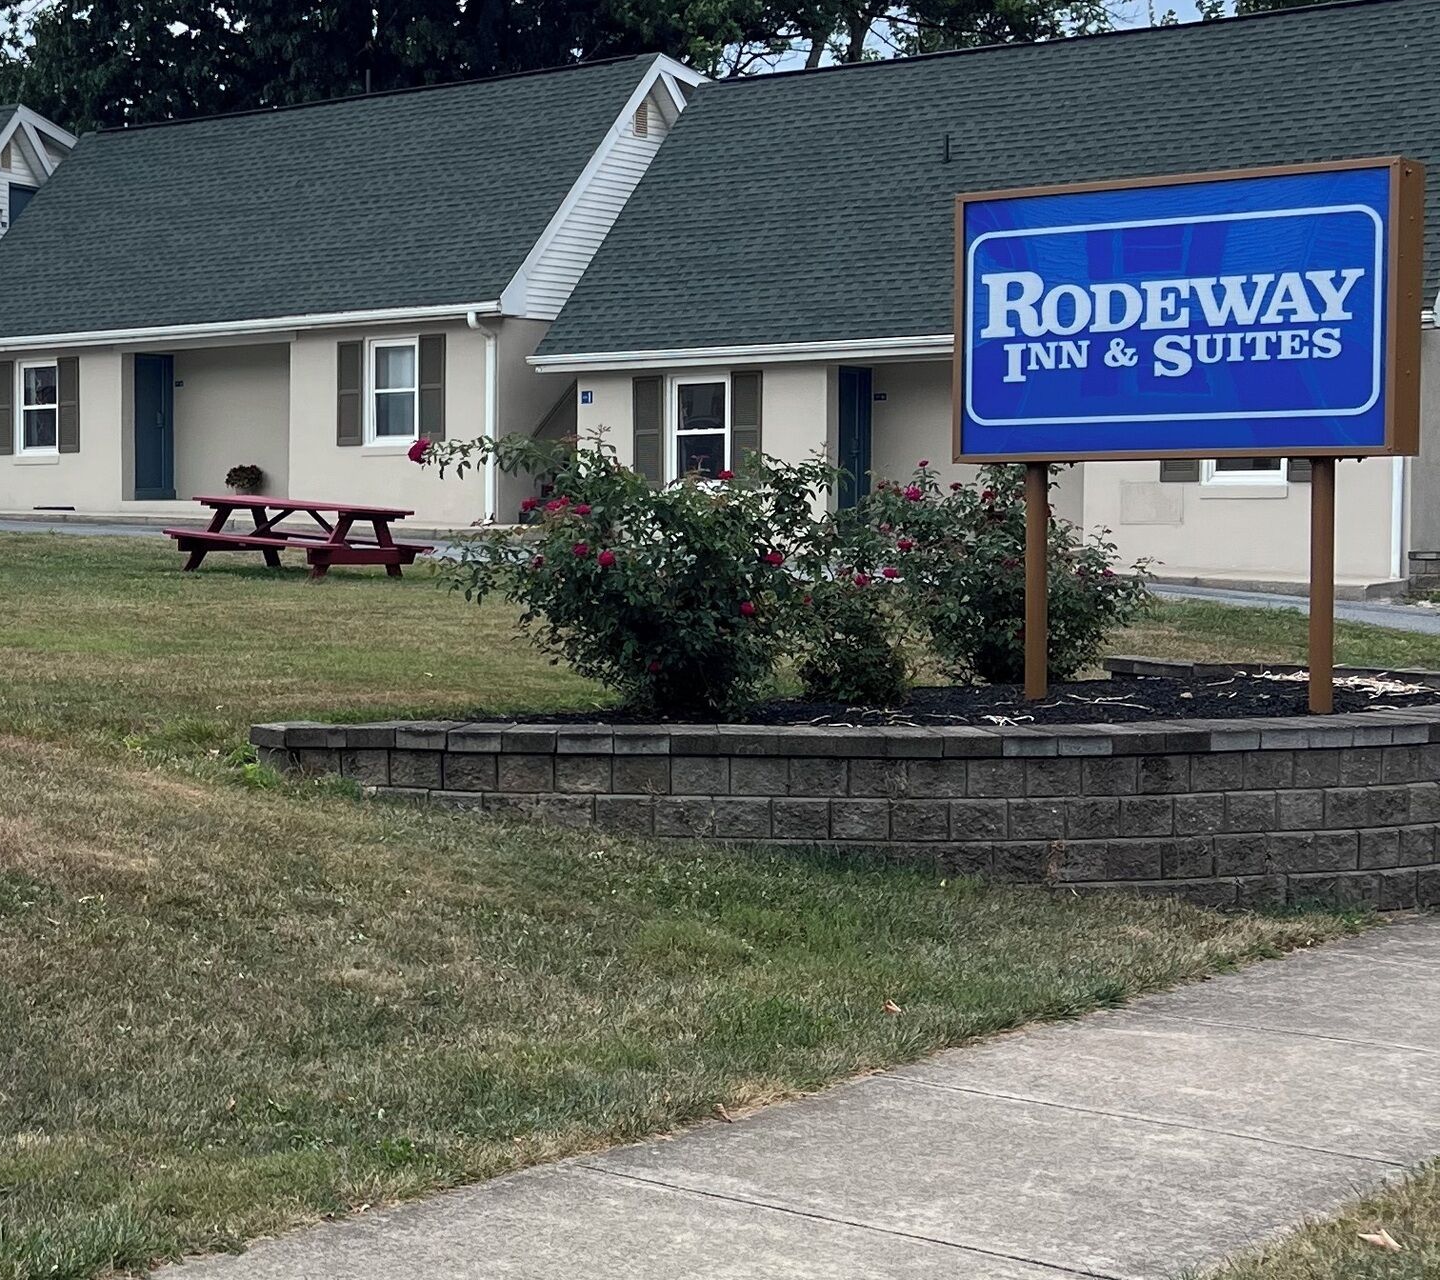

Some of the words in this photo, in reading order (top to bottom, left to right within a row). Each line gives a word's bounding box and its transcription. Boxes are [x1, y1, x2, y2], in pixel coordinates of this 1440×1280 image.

[980, 267, 1365, 339] RODEWAY
[1003, 340, 1090, 383] INN
[1103, 337, 1139, 368] &
[1153, 327, 1342, 377] SUITES
